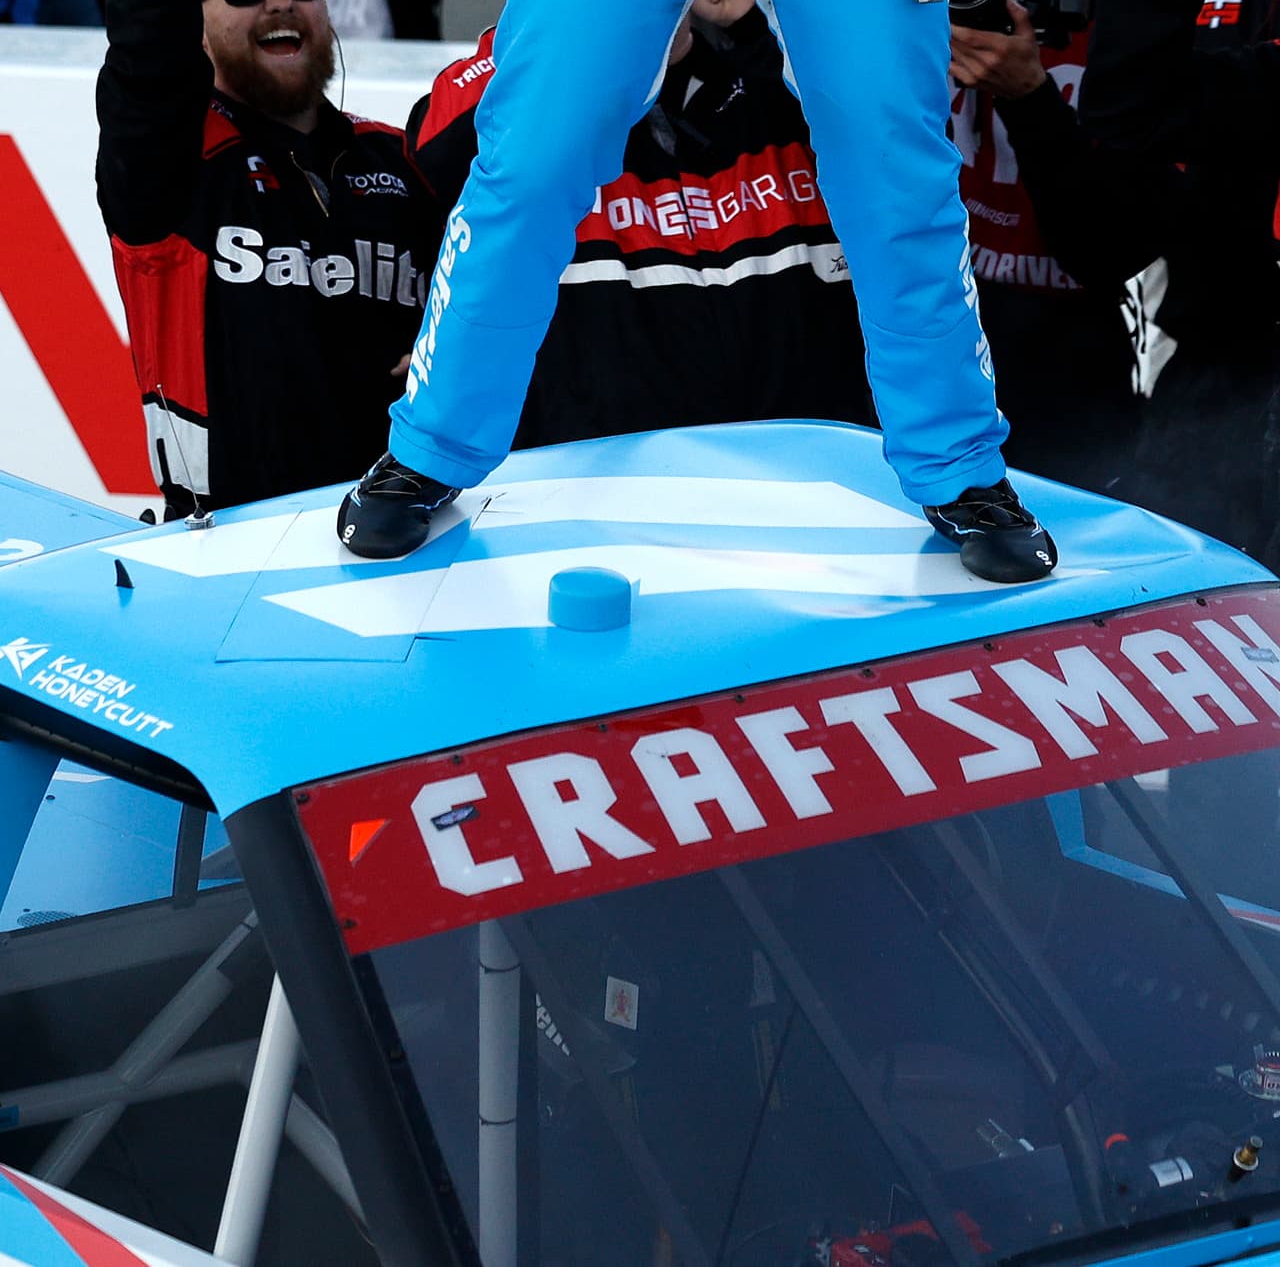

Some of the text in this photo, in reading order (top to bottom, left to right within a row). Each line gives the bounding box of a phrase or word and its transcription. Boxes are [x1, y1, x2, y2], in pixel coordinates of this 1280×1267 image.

[345, 173, 407, 191] TOYOTA
[47, 654, 137, 699] KADEN
[28, 669, 175, 739] HONEYCUTT
